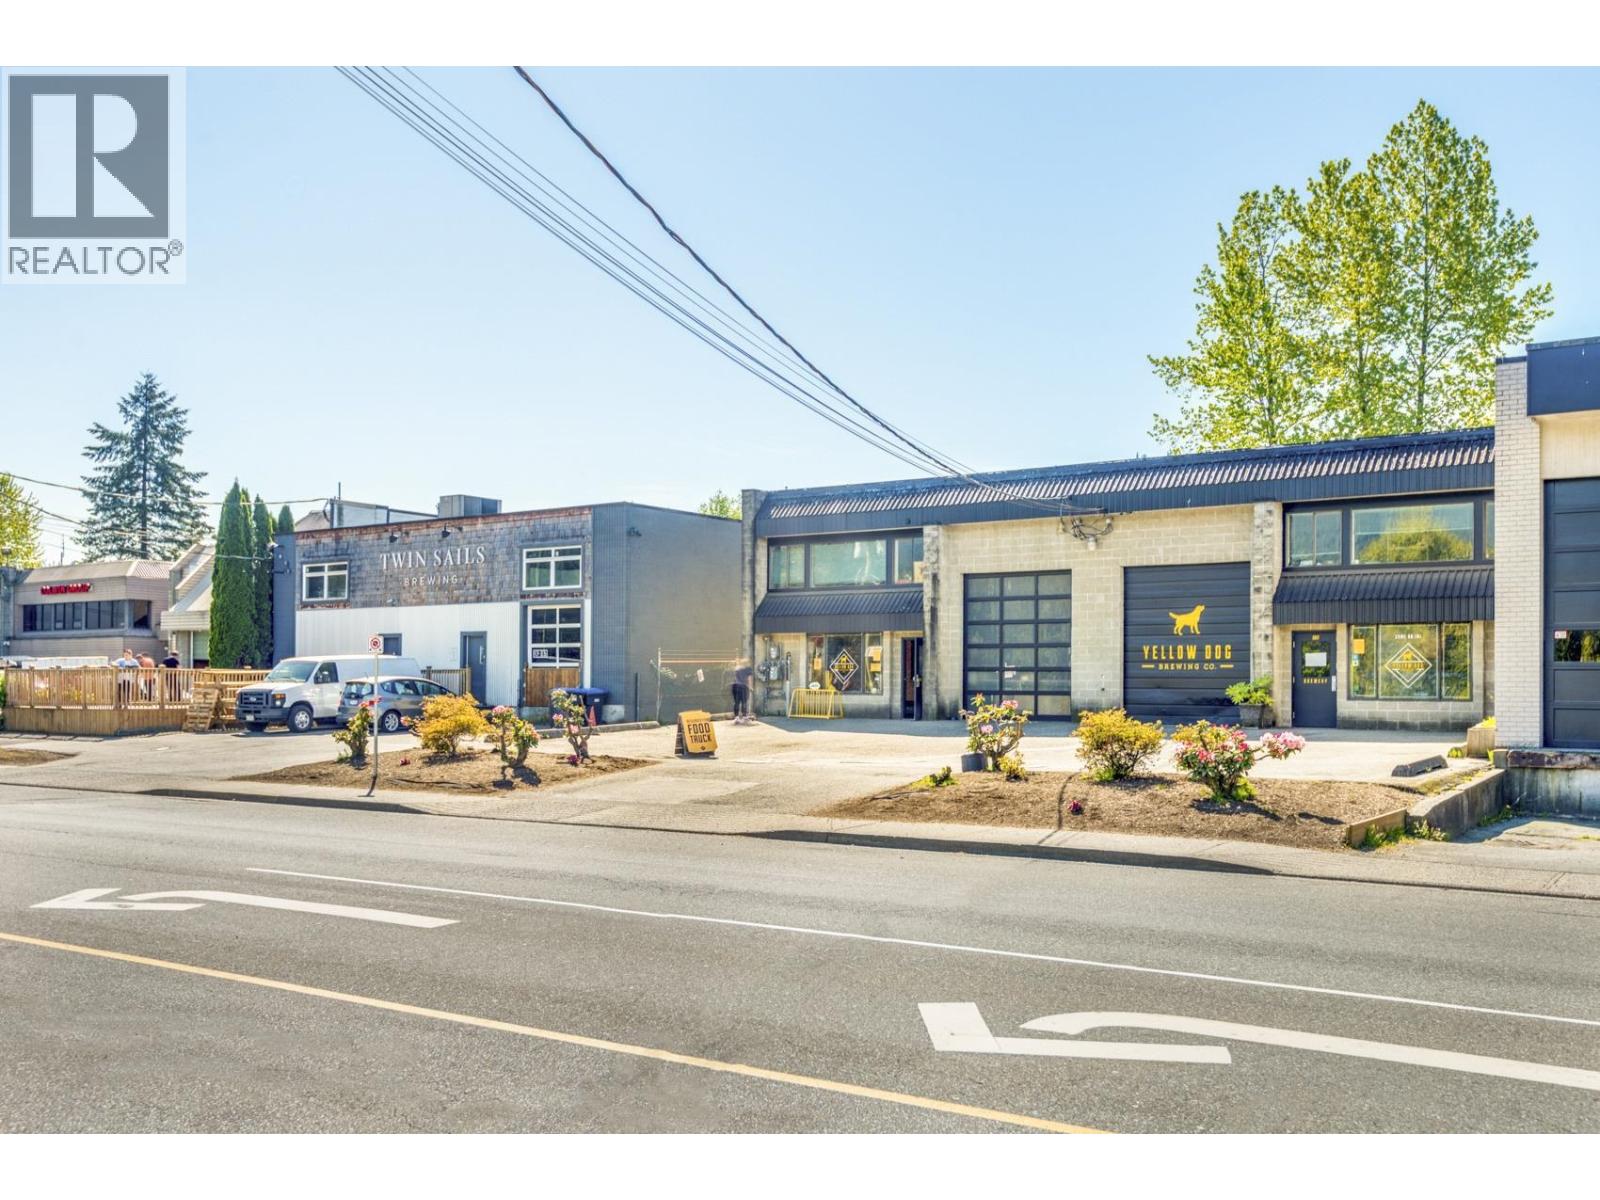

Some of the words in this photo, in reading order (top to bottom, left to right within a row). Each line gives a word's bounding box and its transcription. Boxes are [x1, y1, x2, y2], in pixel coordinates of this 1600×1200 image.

[380, 550, 427, 570] TWIN
[433, 545, 485, 567] SAILS
[404, 574, 458, 586] BREWING
[1143, 644, 1197, 660] YELLOW
[1205, 644, 1232, 660] DOG
[1158, 663, 1200, 671] BREWING
[1203, 663, 1217, 671] CO.
[687, 722, 711, 735] FOOD
[690, 734, 713, 744] TRUCK
